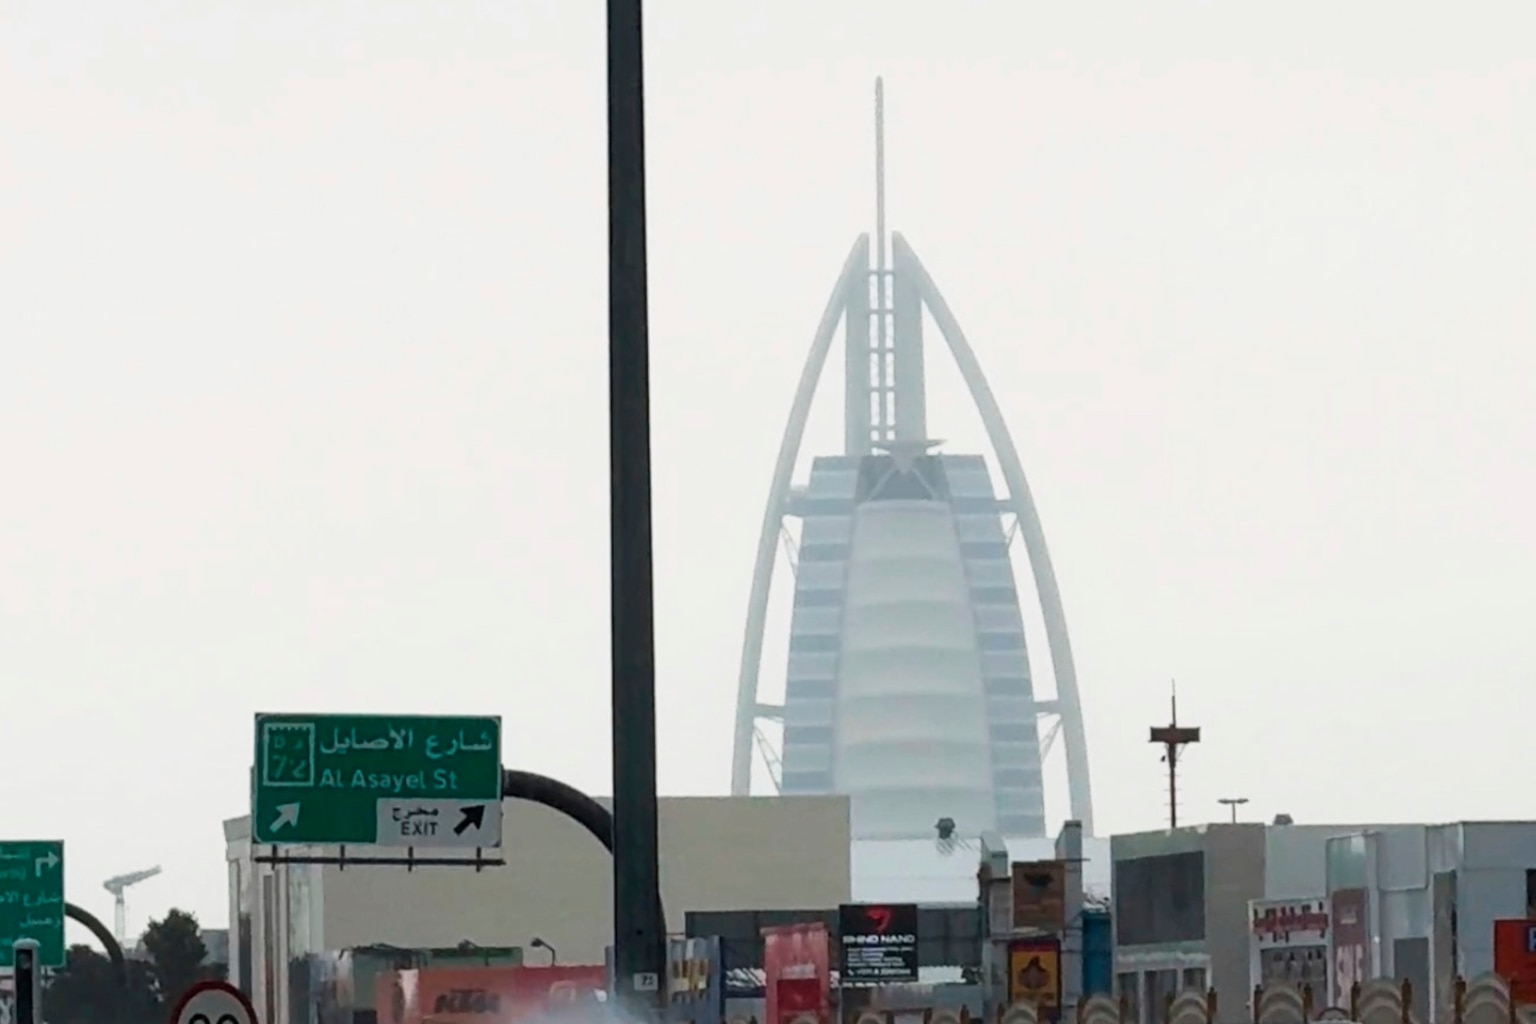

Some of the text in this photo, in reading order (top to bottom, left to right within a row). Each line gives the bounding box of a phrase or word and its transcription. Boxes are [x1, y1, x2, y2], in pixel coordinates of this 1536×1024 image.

[425, 728, 493, 759] شارع
[319, 768, 459, 793] Al Asayel St
[401, 821, 438, 836] EXIT
[880, 935, 916, 944] NANO
